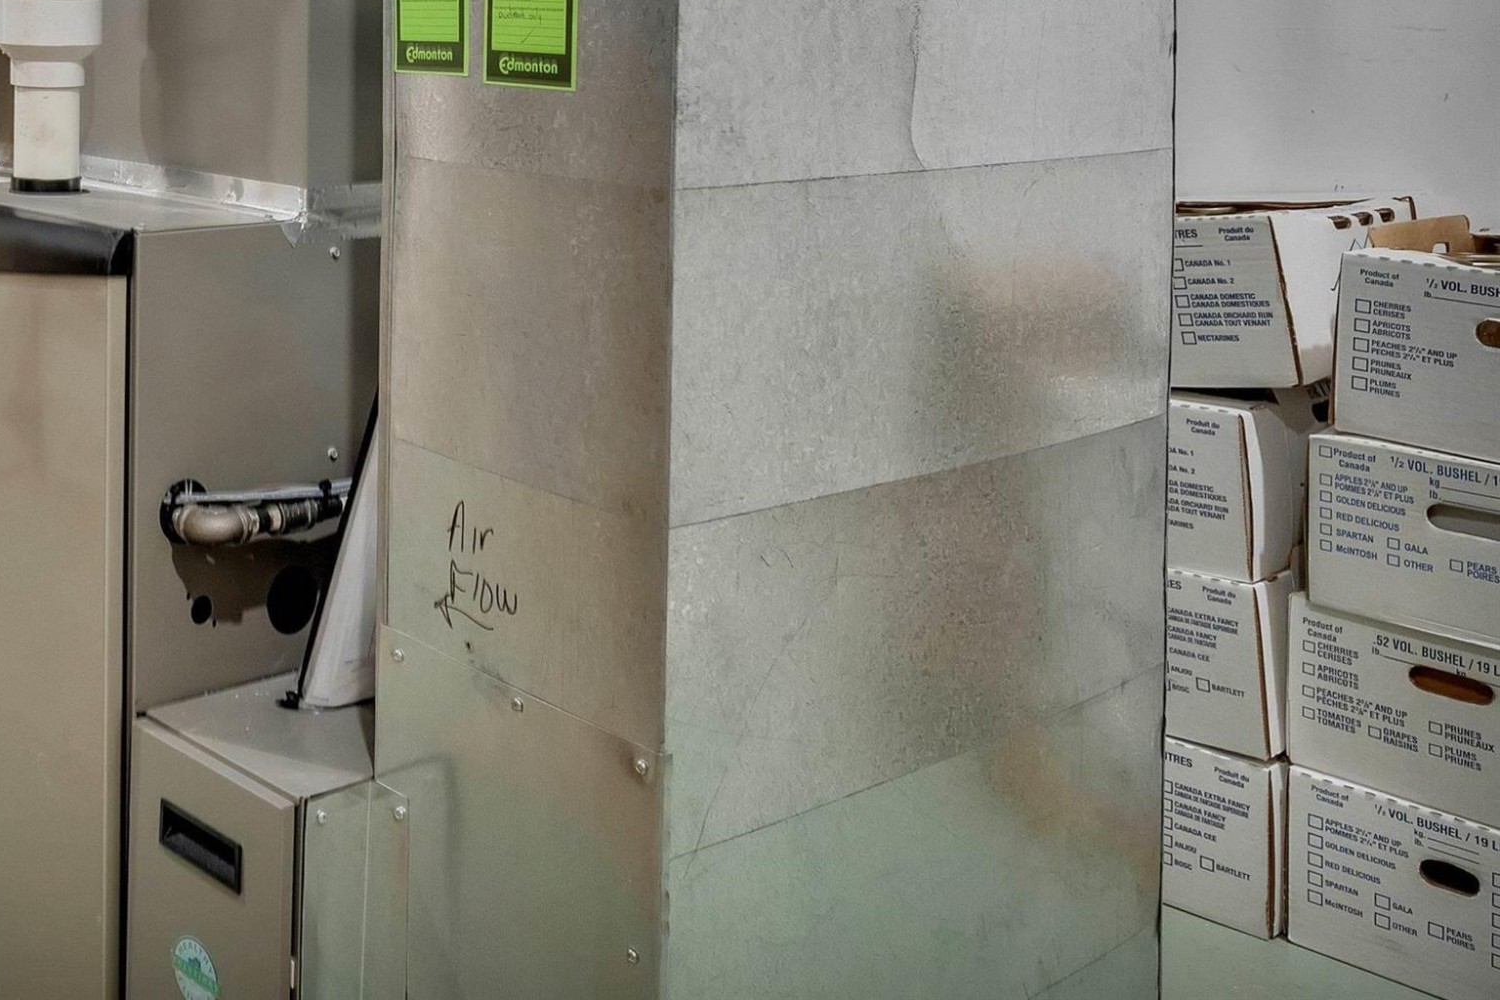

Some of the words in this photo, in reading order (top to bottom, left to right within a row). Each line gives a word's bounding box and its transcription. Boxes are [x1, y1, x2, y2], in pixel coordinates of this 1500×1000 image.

[406, 46, 453, 63] Edmonton
[499, 56, 558, 75] Edmonton
[1224, 234, 1250, 242] Canada
[1360, 268, 1390, 279] Product
[1364, 277, 1394, 287] Canada
[1441, 280, 1467, 293] VOL.
[1222, 300, 1270, 308] DOMESTIQUES
[1373, 300, 1412, 312] CHERRIES
[1373, 308, 1405, 319] CERISES
[1372, 320, 1411, 332] APRICOTS
[1372, 328, 1411, 340] ABRICOTS
[1371, 339, 1406, 352] PEACHES
[1427, 349, 1444, 358] AND
[1370, 359, 1402, 370] PRUNES
[1434, 358, 1454, 368] PLUS
[1370, 367, 1412, 380] PRUNEAUX
[1370, 378, 1396, 389] PLUMS
[1369, 387, 1400, 398] PRUNES
[1186, 418, 1210, 428] Produit
[1191, 427, 1215, 436] Canada
[1333, 448, 1365, 461] Product
[1367, 455, 1376, 463] of
[1339, 459, 1370, 473] Canada
[1407, 459, 1433, 475] VOL.
[1437, 465, 1481, 483] BUSHEL
[1180, 482, 1214, 493] DOMESTIC
[1429, 477, 1440, 489] kg
[1180, 488, 1227, 502] DOMESTIQUES
[1334, 482, 1366, 496] POMMES
[1394, 493, 1414, 504] PLUS
[1181, 499, 1213, 511] ORCHARD
[1335, 495, 1365, 509] GOLDEN
[1367, 500, 1406, 516] DELICIOUS
[1199, 510, 1225, 520] VENANT
[1336, 512, 1353, 522] RED
[1355, 516, 1400, 532] DELICIOUS
[1336, 528, 1374, 543] SPARTAN
[1336, 544, 1378, 561] McINTOSH
[1404, 543, 1428, 555] GALA
[1404, 560, 1434, 573] OTHER
[1467, 561, 1497, 575] PEARS
[1202, 586, 1226, 597] Produit
[1207, 594, 1232, 605] Canada
[1194, 612, 1216, 622] EXTRA
[1217, 617, 1239, 628] FANCY
[1302, 616, 1333, 632] Product
[1335, 626, 1343, 634] of
[1307, 628, 1337, 643] Canada
[1169, 647, 1196, 658] CANADA
[1317, 641, 1359, 659] CHERRIES
[1392, 640, 1418, 655] VOL.
[1422, 646, 1467, 668] BUSHEL
[1477, 660, 1490, 674] 19
[1317, 650, 1353, 666] CERISES
[1317, 664, 1359, 682] APRICOTS
[1317, 672, 1359, 690] ABRICOTS
[1212, 684, 1244, 697] BARTLETT
[1316, 687, 1354, 704] PEACHES
[1374, 703, 1392, 716] AND
[1394, 709, 1408, 719] UP
[1317, 708, 1362, 728] TOMATOES
[1317, 716, 1356, 734] TOMATES
[1382, 714, 1405, 728] PLUS
[1383, 727, 1418, 744] GRAPES
[1444, 723, 1482, 740] PRUNES
[1383, 736, 1418, 753] RAISINS
[1444, 732, 1495, 753] PRUNEAUX
[1444, 745, 1477, 761] PLUMS
[1444, 754, 1482, 771] PRUNES
[1214, 766, 1239, 778] Produit
[1219, 775, 1244, 788] Canada
[1174, 782, 1202, 796] CANADA
[1204, 791, 1226, 803] EXTRA
[1228, 798, 1250, 811] FANCY
[1311, 784, 1340, 799] Product
[1316, 794, 1344, 808] Canada
[1174, 801, 1202, 815] CANADA
[1203, 810, 1226, 822] FANCY
[1174, 822, 1202, 837] CANADA
[1325, 818, 1354, 833] APPLES
[1373, 832, 1390, 844] AND
[1388, 808, 1413, 824] VOL.
[1417, 816, 1463, 840] BUSHEL
[1475, 835, 1489, 848] 19
[1325, 826, 1358, 844] POMMES
[1389, 846, 1409, 858] PLUS
[1325, 841, 1355, 856] GOLDEN
[1356, 851, 1396, 870] DELICIOUS
[1216, 863, 1250, 881] BARTLETT
[1325, 860, 1340, 871] RED
[1342, 865, 1381, 884] DELICIOUS
[1325, 879, 1359, 896] SPARTAN
[1325, 898, 1363, 918] McINTOSH
[1392, 902, 1413, 915] GALA
[1392, 922, 1418, 937] OTHER
[1446, 927, 1473, 941] PEARS
[1446, 935, 1476, 951] POIRES
